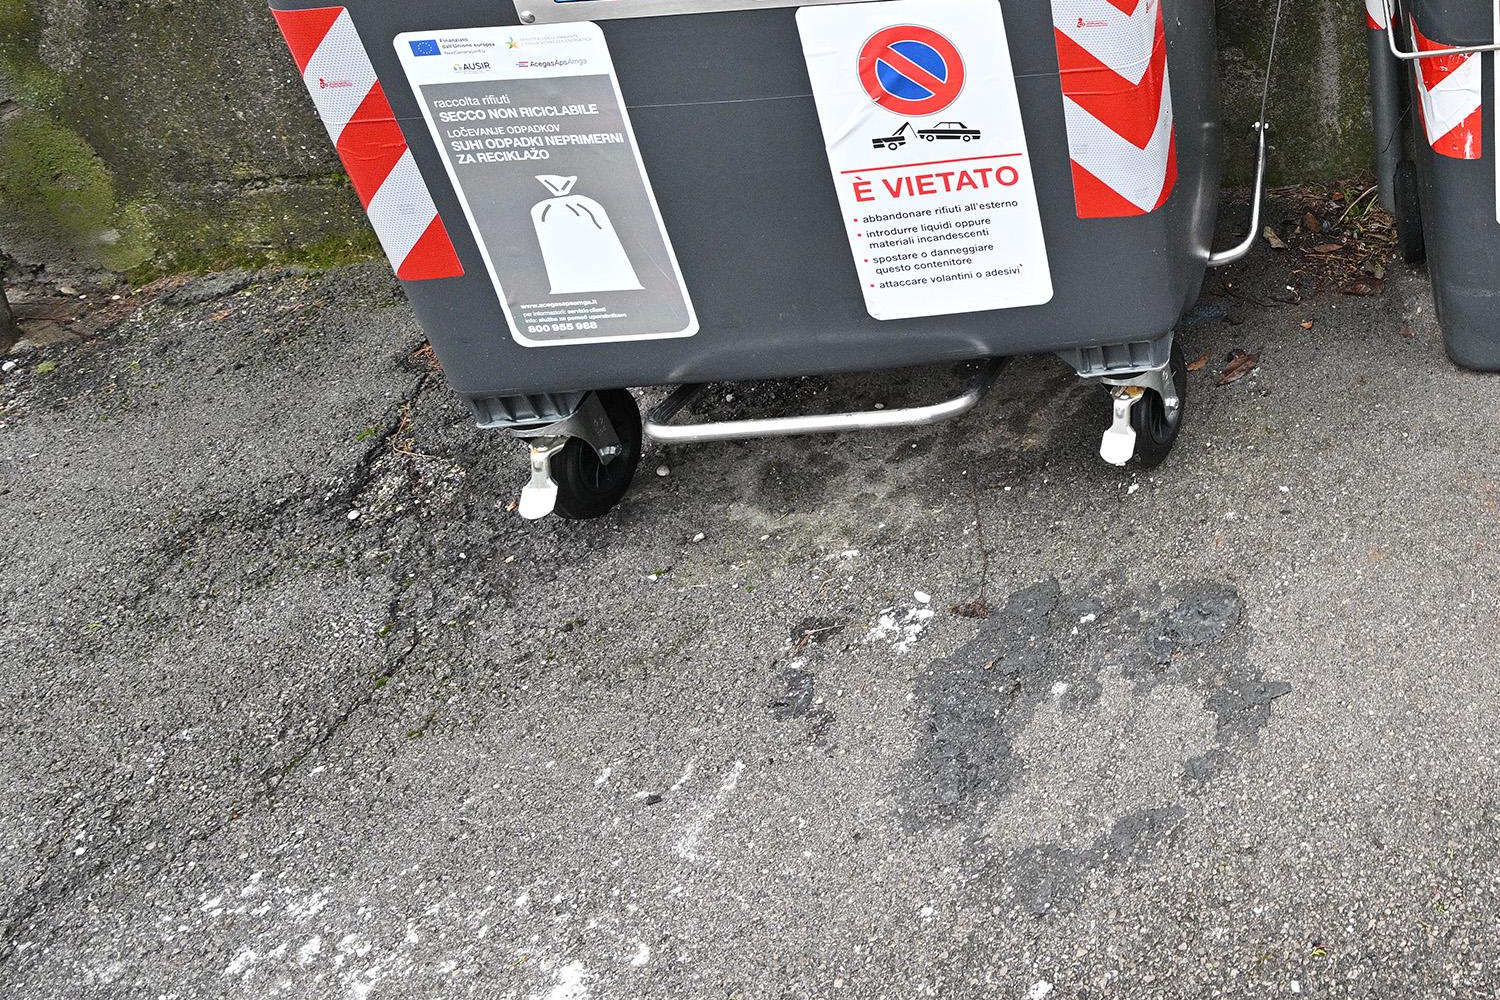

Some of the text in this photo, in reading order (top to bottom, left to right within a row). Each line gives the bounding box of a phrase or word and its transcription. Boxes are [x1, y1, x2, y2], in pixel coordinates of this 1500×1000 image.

[463, 62, 490, 71] AUSIR
[530, 58, 587, 69] AcegasApsAmga
[434, 94, 510, 109] raccolta rifiuti
[440, 104, 599, 122] SECCO NON RICICLABILE
[447, 123, 560, 138] LOČEVANJE ODPADKOV
[451, 133, 624, 151] SUHI ODPADKI NEPRIMERNI
[456, 148, 549, 165] ZA RECIKLAŽO
[853, 165, 1018, 202] È VIETATO
[863, 200, 1018, 224] abbandonare rifiuti all'esterno
[866, 218, 991, 238] introdurre liquidi oppure
[869, 228, 989, 249] materiali incandescenti
[873, 252, 918, 265] spostare
[931, 243, 994, 257] danneggiare
[876, 257, 972, 276] questo contenitore
[879, 276, 927, 289] attaccare
[930, 271, 973, 283] volantini
[985, 265, 1020, 278] adesivi
[528, 321, 597, 333] 800 955 988
